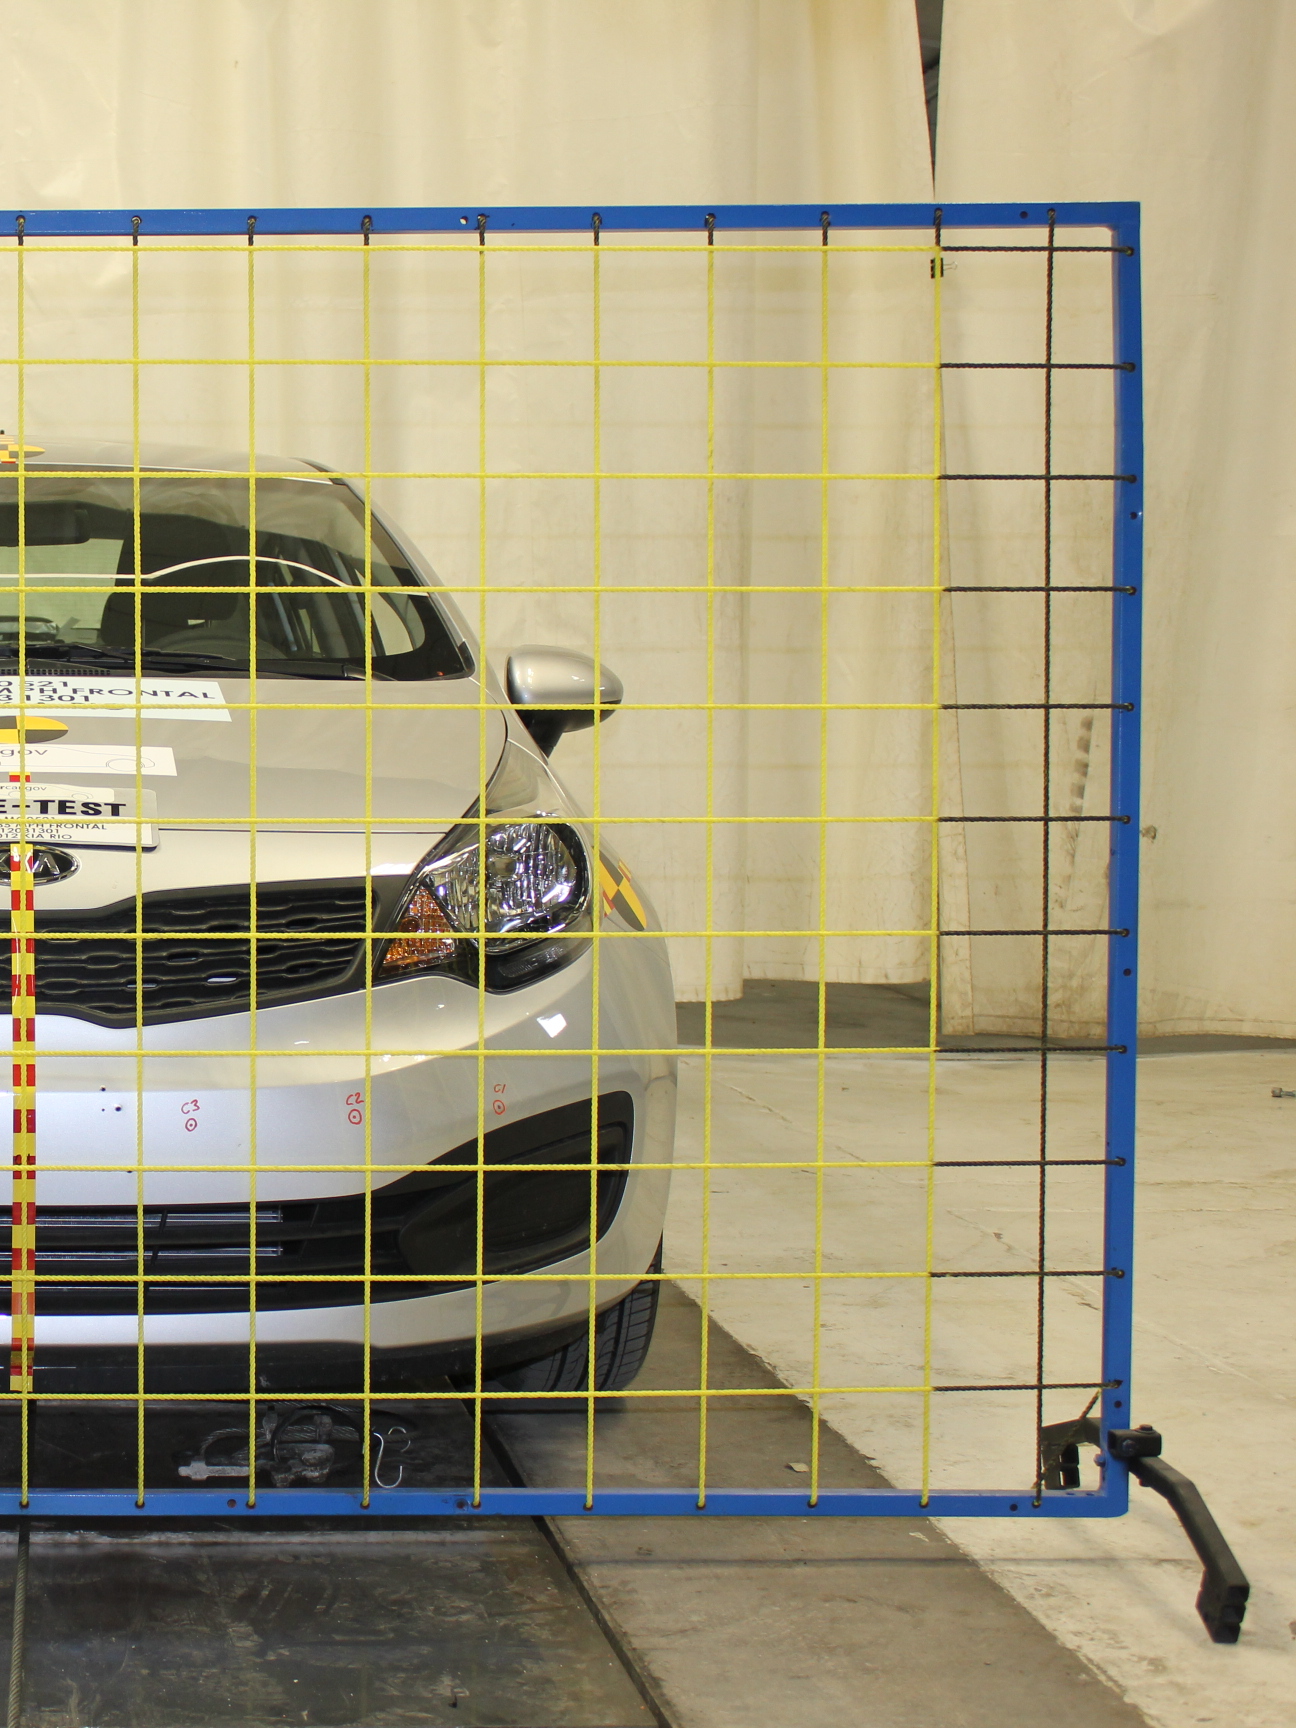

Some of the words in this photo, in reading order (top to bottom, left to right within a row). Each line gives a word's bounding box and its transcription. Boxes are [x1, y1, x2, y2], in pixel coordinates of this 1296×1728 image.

[71, 688, 216, 699] FRONTAL
[346, 1092, 365, 1105] C2
[180, 1099, 201, 1114] C3
